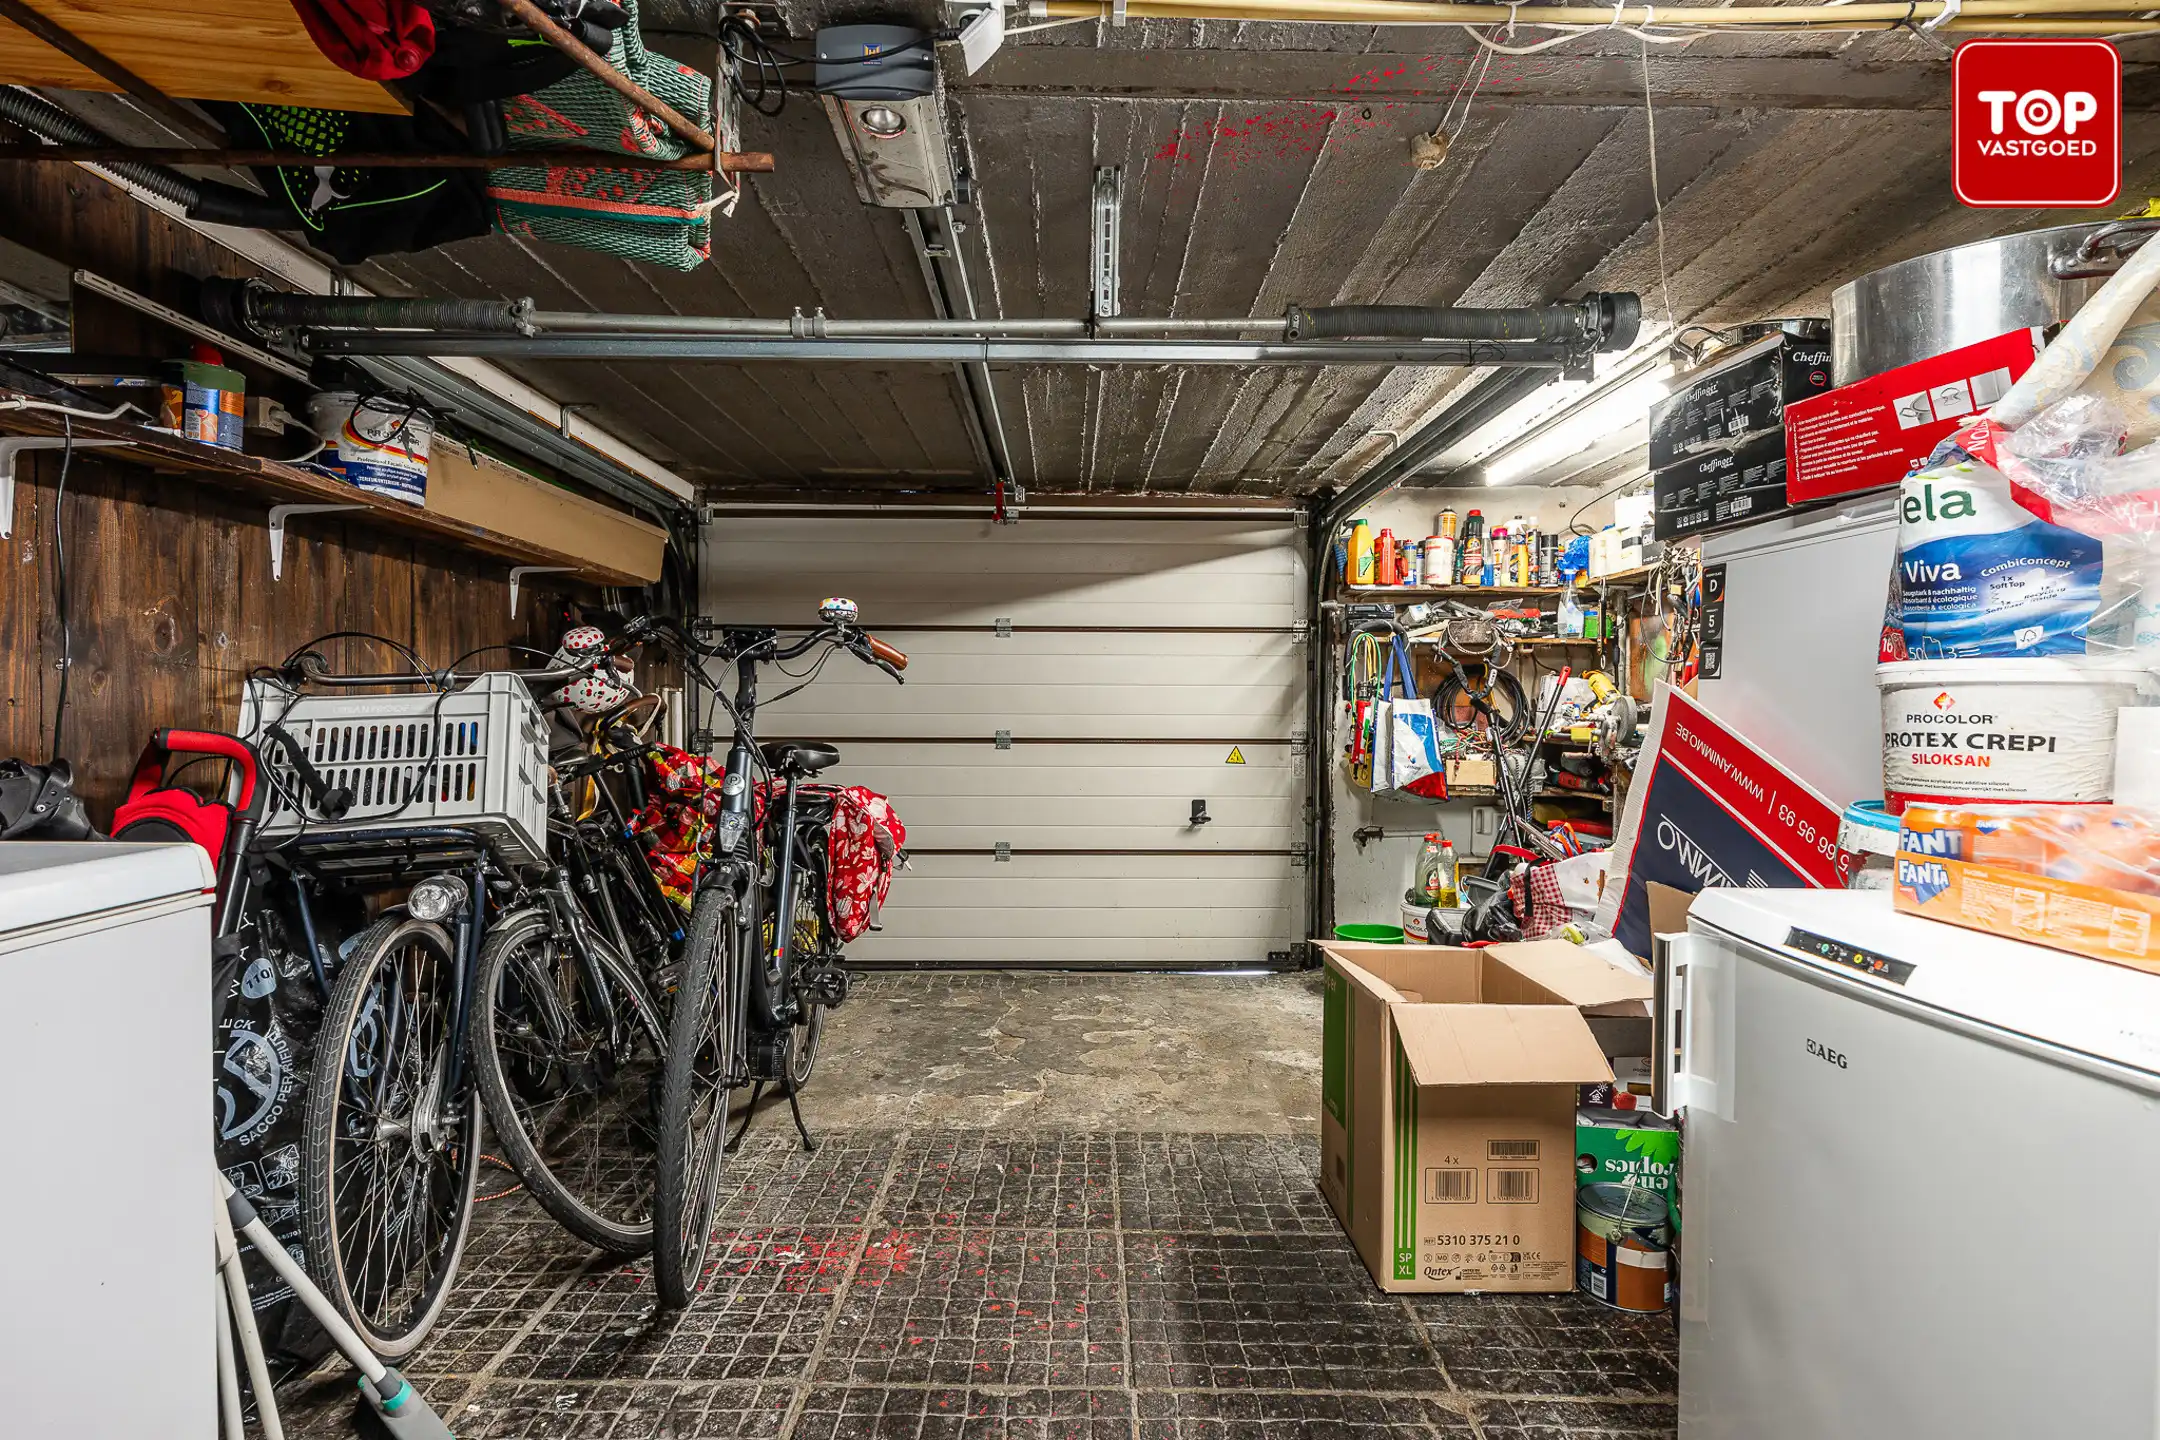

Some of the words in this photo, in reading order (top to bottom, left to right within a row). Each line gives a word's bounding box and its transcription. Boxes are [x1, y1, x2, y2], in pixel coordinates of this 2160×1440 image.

[1793, 351, 1832, 365] Cheffin
[1699, 456, 1734, 473] Cheffinger
[1899, 484, 1976, 524] ela
[1905, 560, 1962, 583] Viva
[1981, 557, 2071, 577] CombiConcept
[1710, 580, 1717, 592] D
[1932, 586, 1977, 595] nachhaltig
[1990, 582, 2007, 590] Soft
[1932, 594, 1978, 603] écologique
[1938, 602, 1977, 610] ecologica
[1708, 615, 1715, 627] 5
[1906, 714, 1993, 724] PROCOLOR
[1884, 732, 1958, 748] PROTEX
[1966, 733, 2057, 753] CREPI
[1675, 722, 1765, 803] WWW.ANIMMO.BE
[1912, 753, 1991, 767] SILOKSAN
[1778, 804, 1796, 827] 93
[1797, 820, 1816, 843] 95
[1817, 836, 1836, 860] 66
[1901, 828, 1961, 854] FANT
[1899, 860, 1950, 886] FANTA
[1817, 1043, 1847, 1069] AEG
[239, 1105, 283, 1146] SACCO
[277, 1076, 293, 1102] PER
[1437, 1235, 1466, 1245] 5310
[1470, 1235, 1491, 1245] 375
[1495, 1235, 1508, 1245] 21
[1512, 1235, 1520, 1245] 0
[1398, 1253, 1412, 1263] SP
[1398, 1265, 1412, 1275] XL
[1424, 1266, 1454, 1279] Ontex
